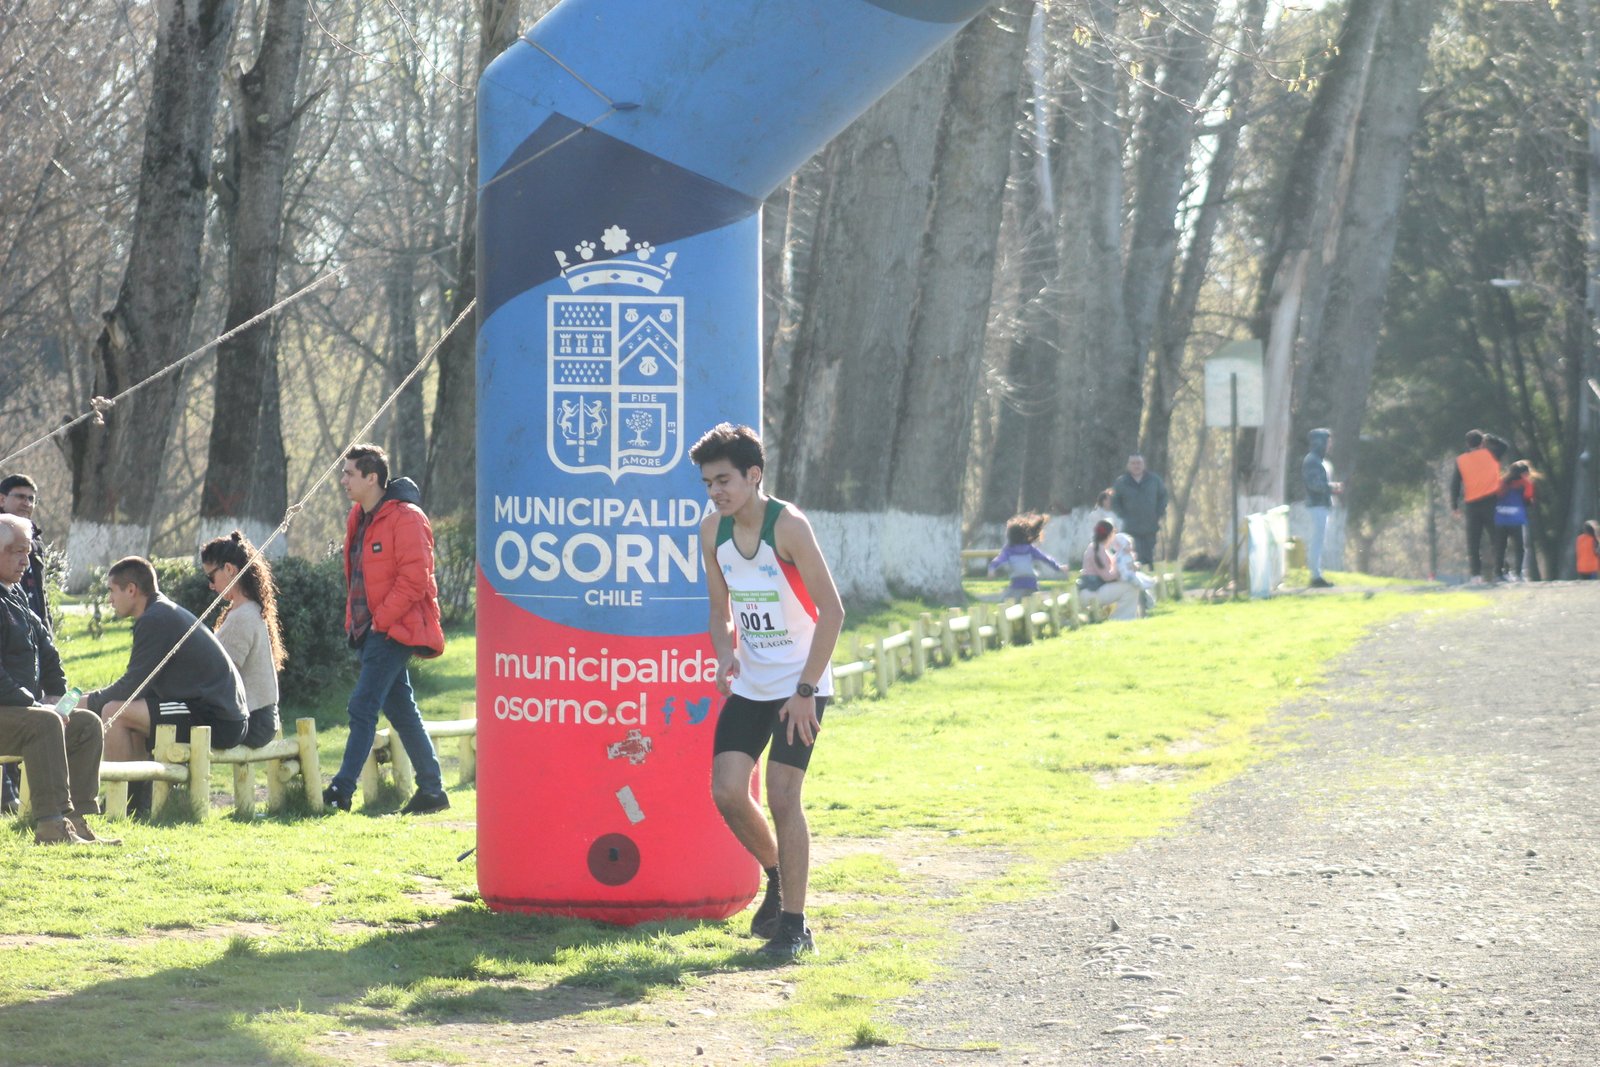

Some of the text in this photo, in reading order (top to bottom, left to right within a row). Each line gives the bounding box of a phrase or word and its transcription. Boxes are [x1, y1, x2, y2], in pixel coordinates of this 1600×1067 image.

[631, 393, 657, 402] FIDE
[667, 421, 676, 435] ET
[622, 456, 661, 466] AMORE
[494, 530, 706, 583] OSORN
[584, 589, 643, 606] CHILE
[740, 611, 775, 631] 001
[494, 646, 733, 691] municipalida
[494, 692, 647, 726] osorno.cl
